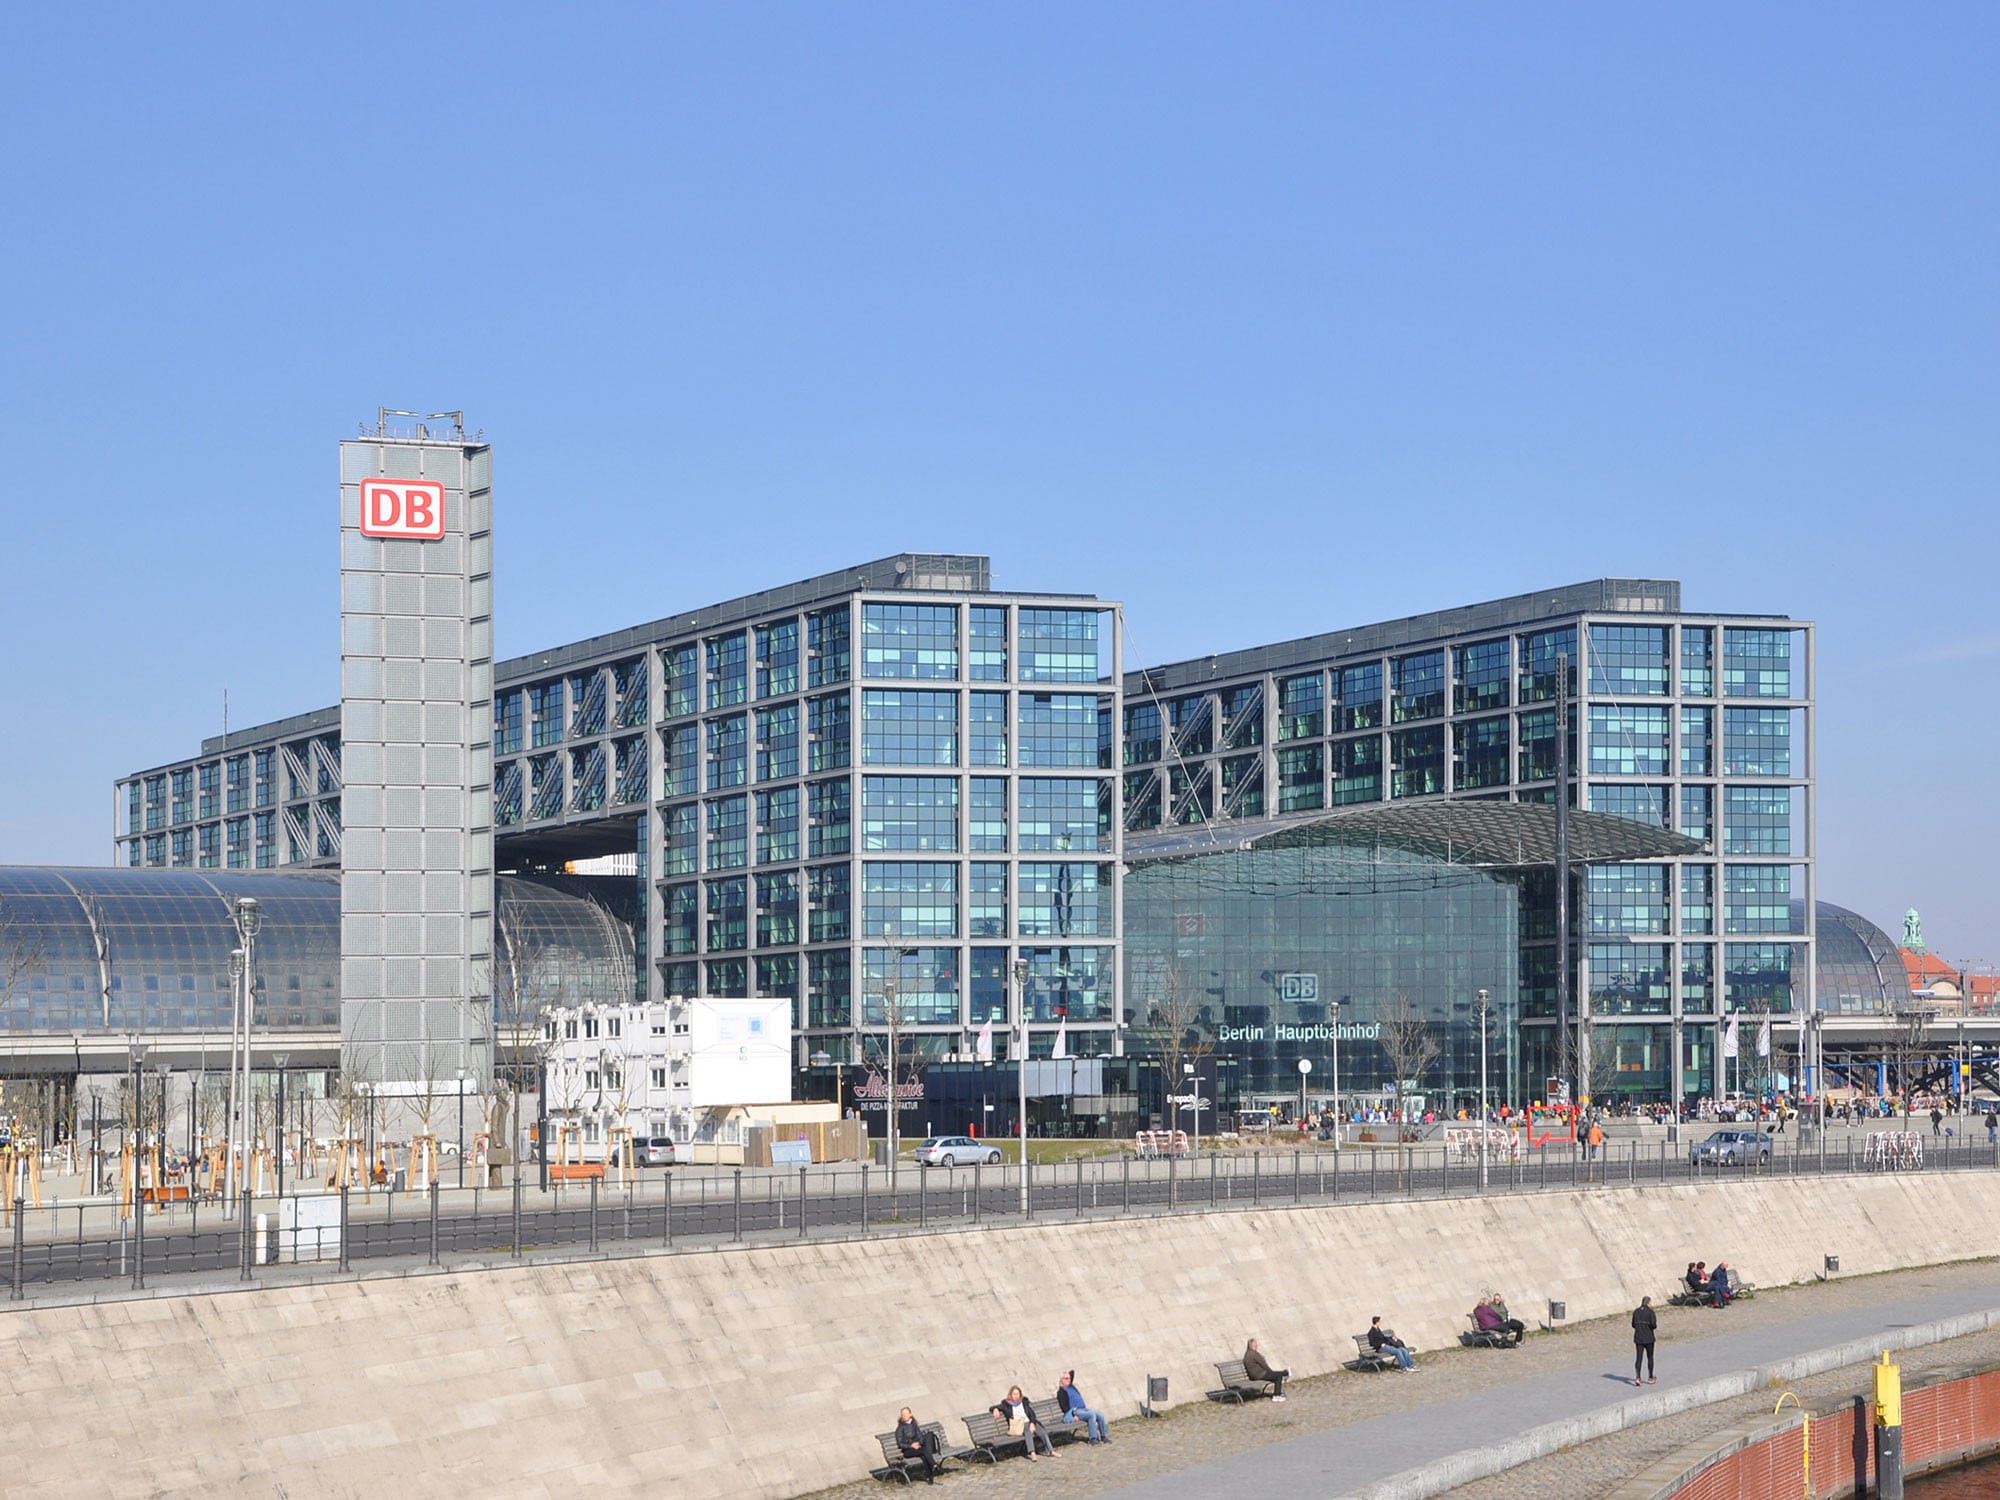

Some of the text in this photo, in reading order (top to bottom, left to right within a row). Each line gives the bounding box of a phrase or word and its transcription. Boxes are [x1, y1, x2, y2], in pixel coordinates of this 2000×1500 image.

[371, 488, 434, 529] DB
[1286, 977, 1314, 997] DB
[1219, 1023, 1381, 1043] Berlin Hauptbahnhof
